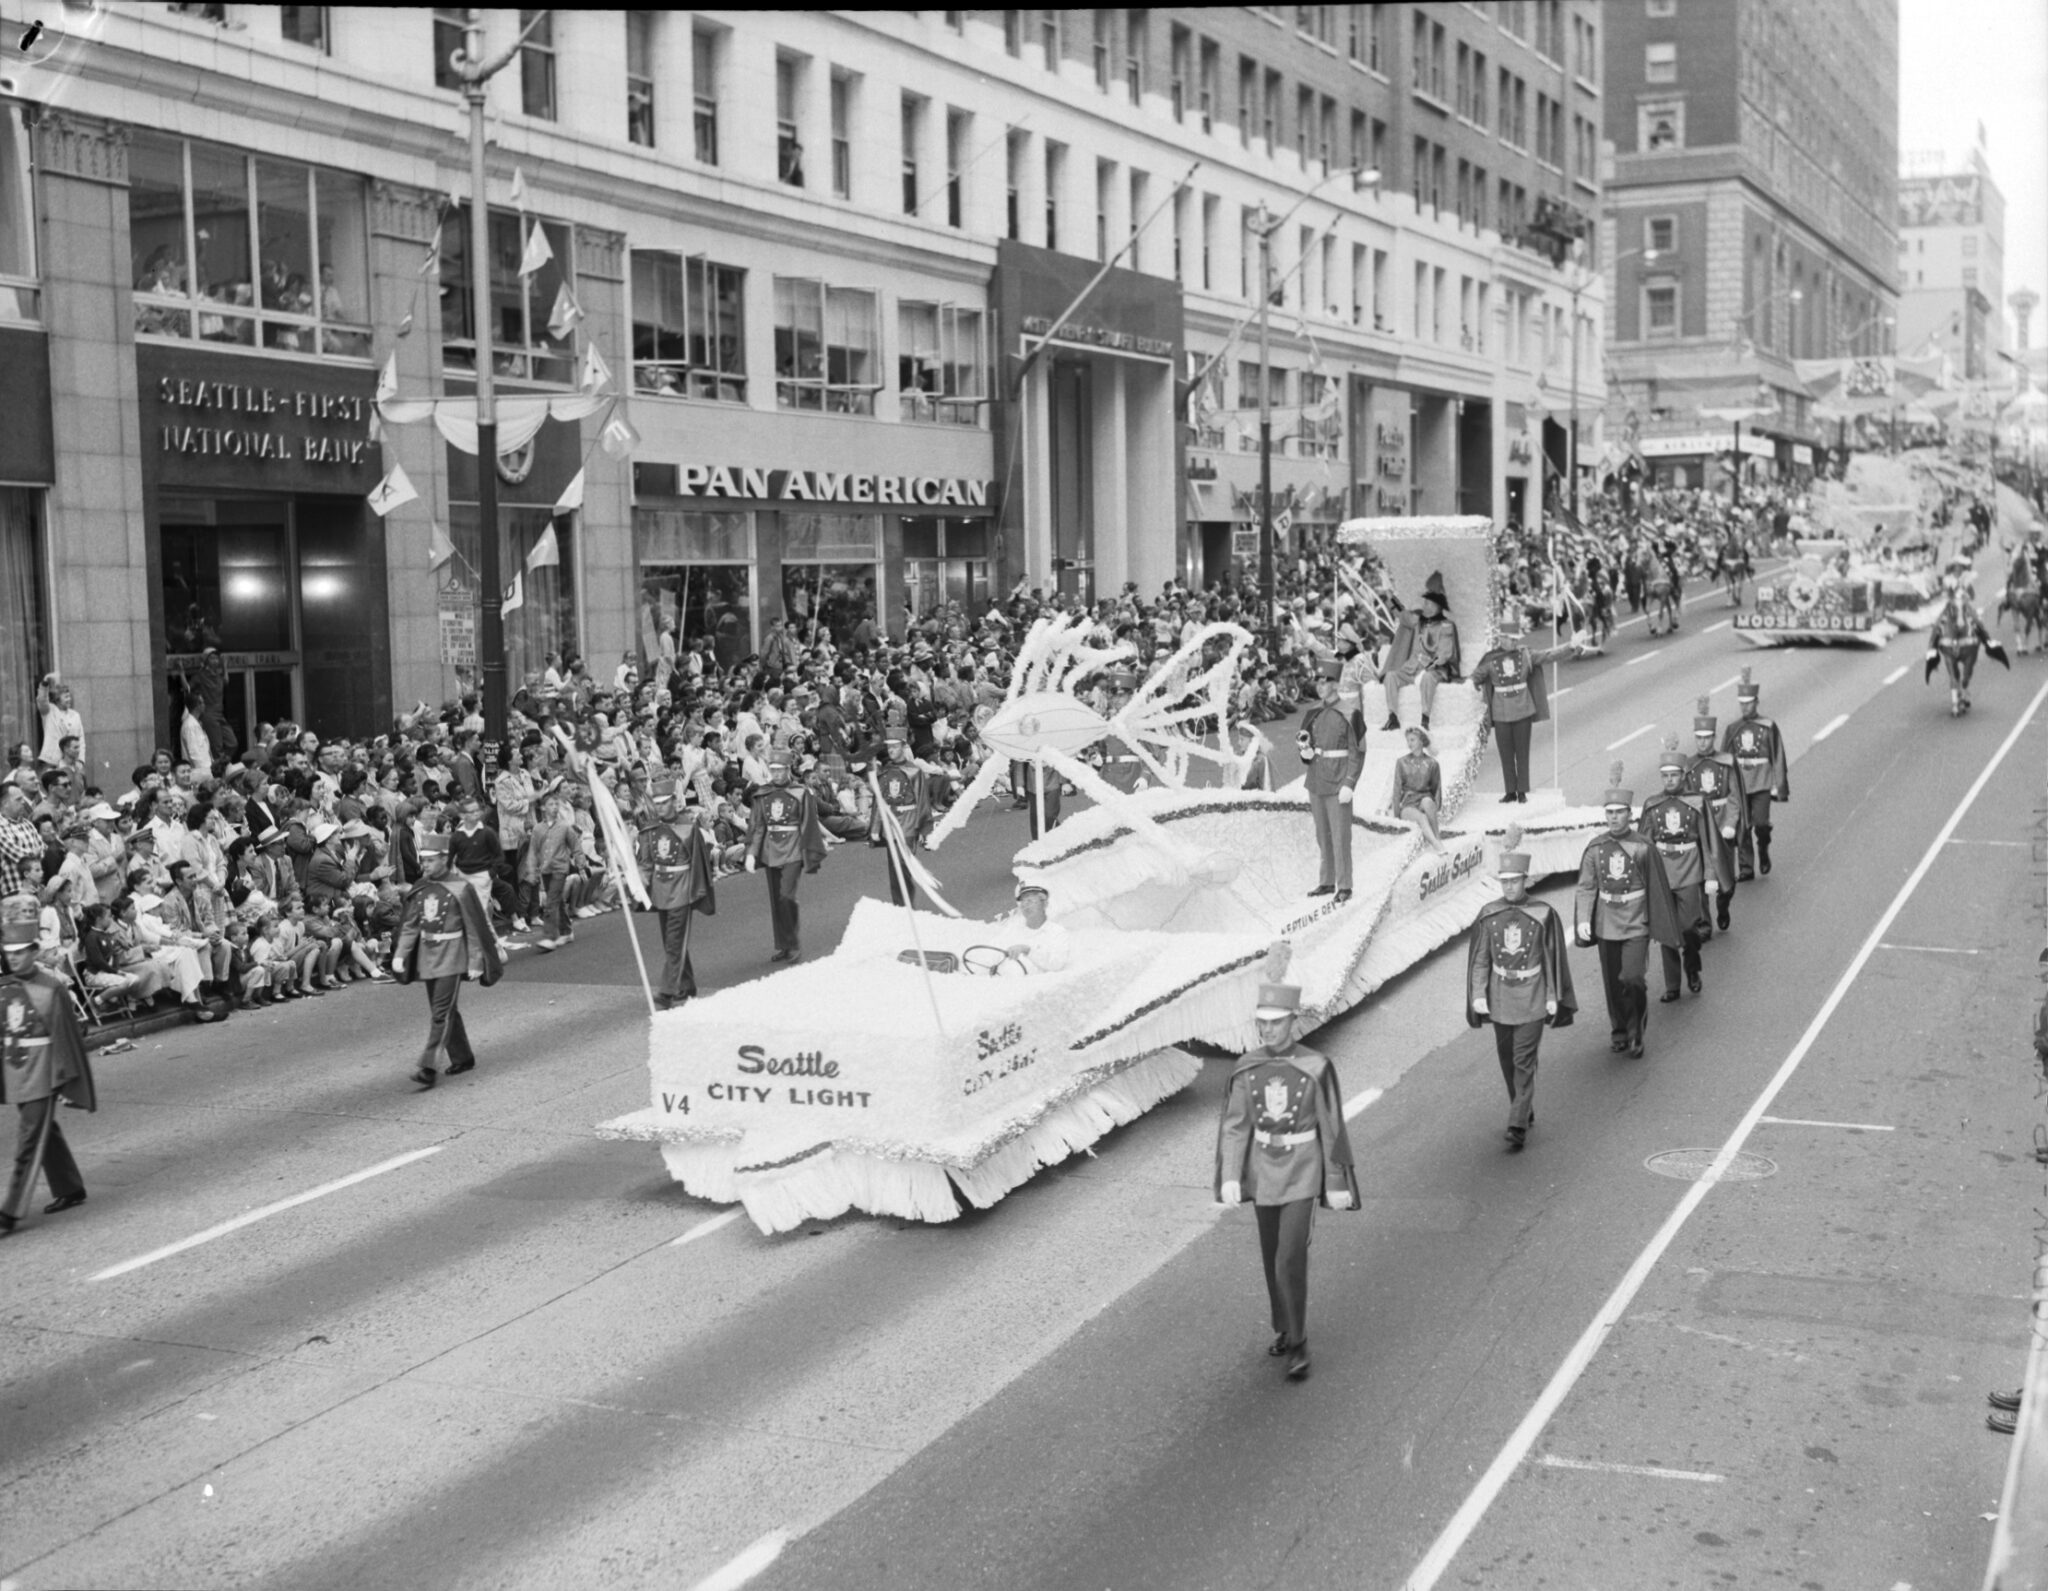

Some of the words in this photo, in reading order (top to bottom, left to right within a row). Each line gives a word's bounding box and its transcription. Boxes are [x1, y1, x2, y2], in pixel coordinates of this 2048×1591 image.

[162, 425, 292, 459] NATIONAL
[304, 437, 365, 465] BANK
[679, 463, 769, 499] PAN
[781, 470, 991, 506] AMERICAN
[1737, 614, 1798, 628] MOOSE
[1809, 615, 1867, 630] LODGE
[736, 1044, 841, 1078] Seattle
[662, 1092, 691, 1115] V4
[707, 1083, 773, 1103] CITY
[788, 1087, 873, 1108] LIGHT
